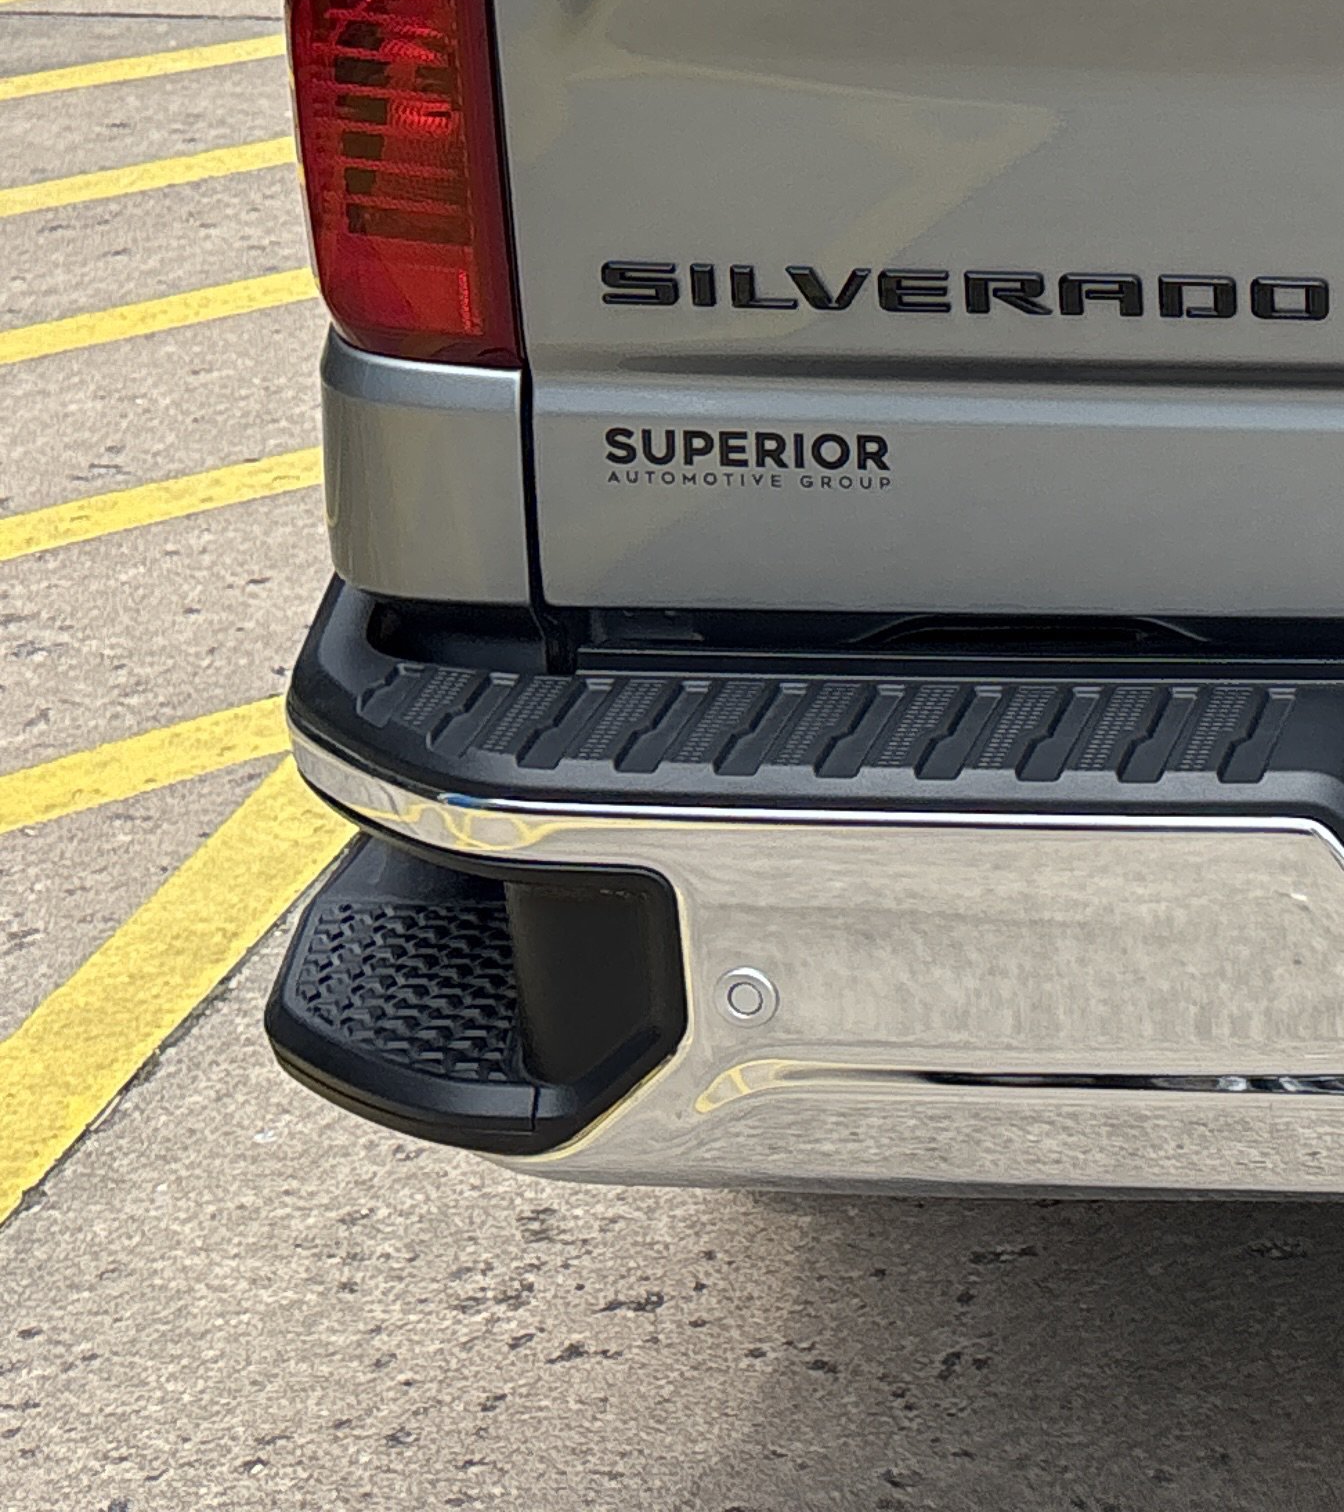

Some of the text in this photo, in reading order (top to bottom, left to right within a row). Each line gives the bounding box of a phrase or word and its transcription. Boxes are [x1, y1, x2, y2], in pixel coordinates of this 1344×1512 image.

[600, 259, 1330, 322] SILVERADO
[605, 427, 890, 471] SUPERIOR
[607, 470, 892, 489] AUTOMOTIVE GROUP
